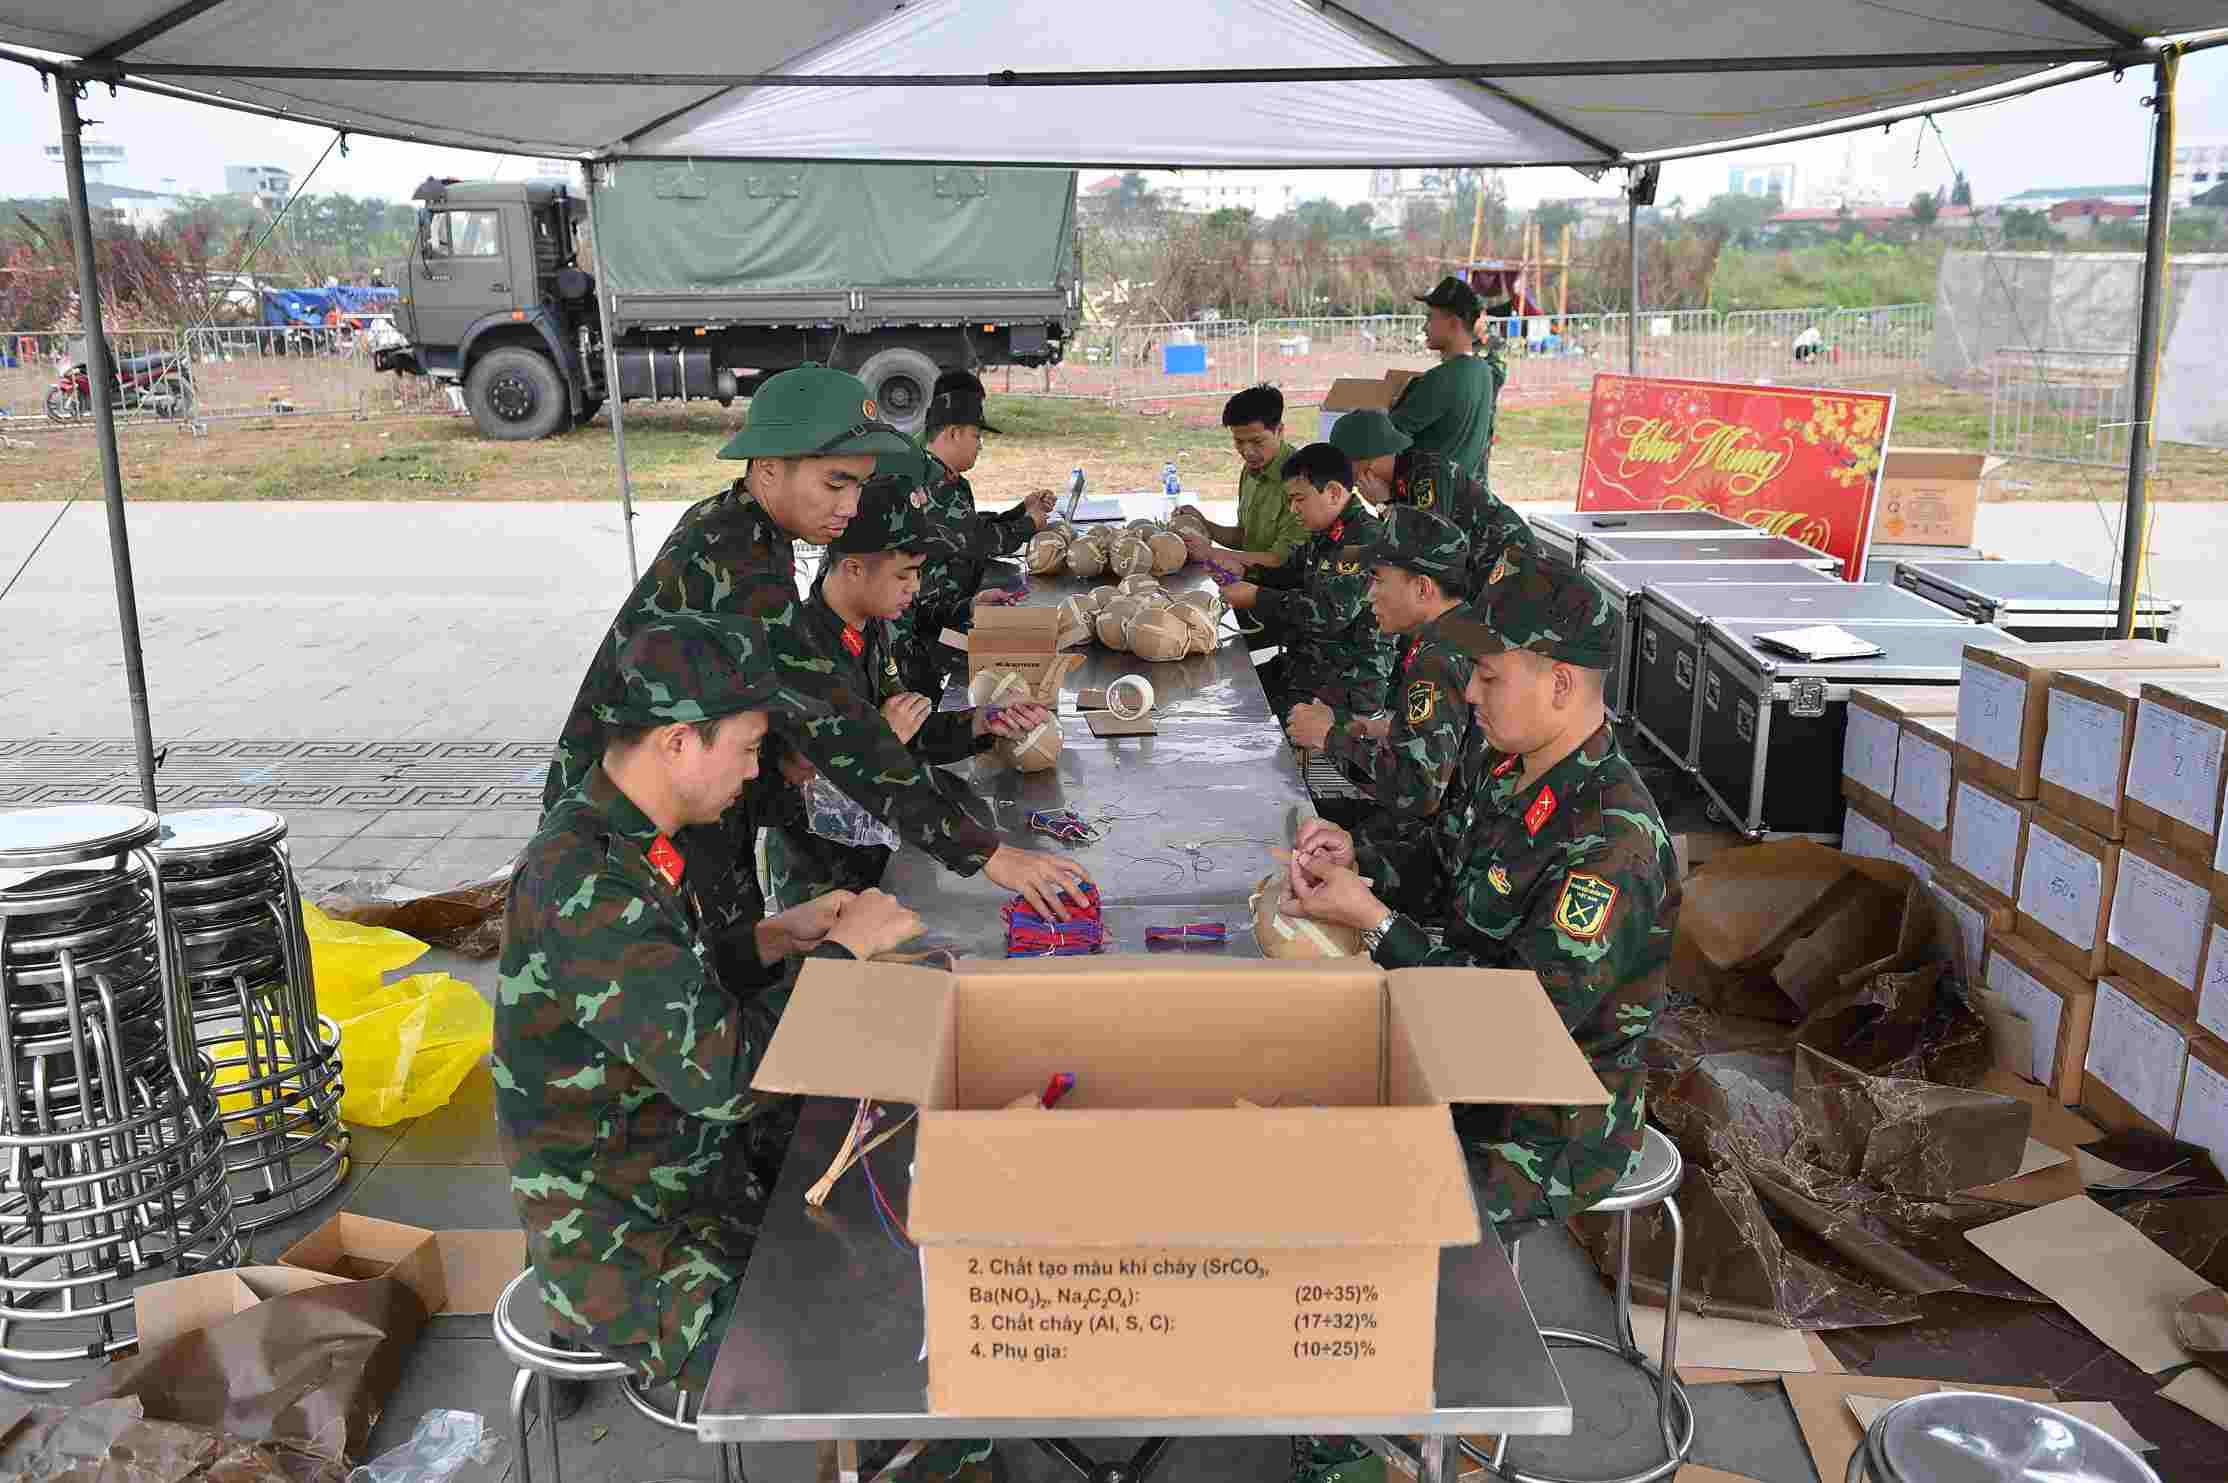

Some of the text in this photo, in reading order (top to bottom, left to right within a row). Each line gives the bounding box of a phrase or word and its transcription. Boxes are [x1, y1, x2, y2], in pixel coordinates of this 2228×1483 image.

[968, 1258, 984, 1275] 2.
[990, 1255, 1033, 1275] Chất
[1038, 1259, 1068, 1279] tạo
[1073, 1258, 1113, 1276] màu
[1152, 1257, 1197, 1279] cháy
[969, 1314, 985, 1331] 3.
[991, 1311, 1034, 1331] Chất
[1039, 1313, 1083, 1335] cháy
[1126, 1315, 1144, 1333] S,
[1150, 1314, 1176, 1334] C):
[969, 1342, 986, 1359] 4.
[992, 1342, 1028, 1361] Phụ
[1033, 1343, 1067, 1362] gia:
